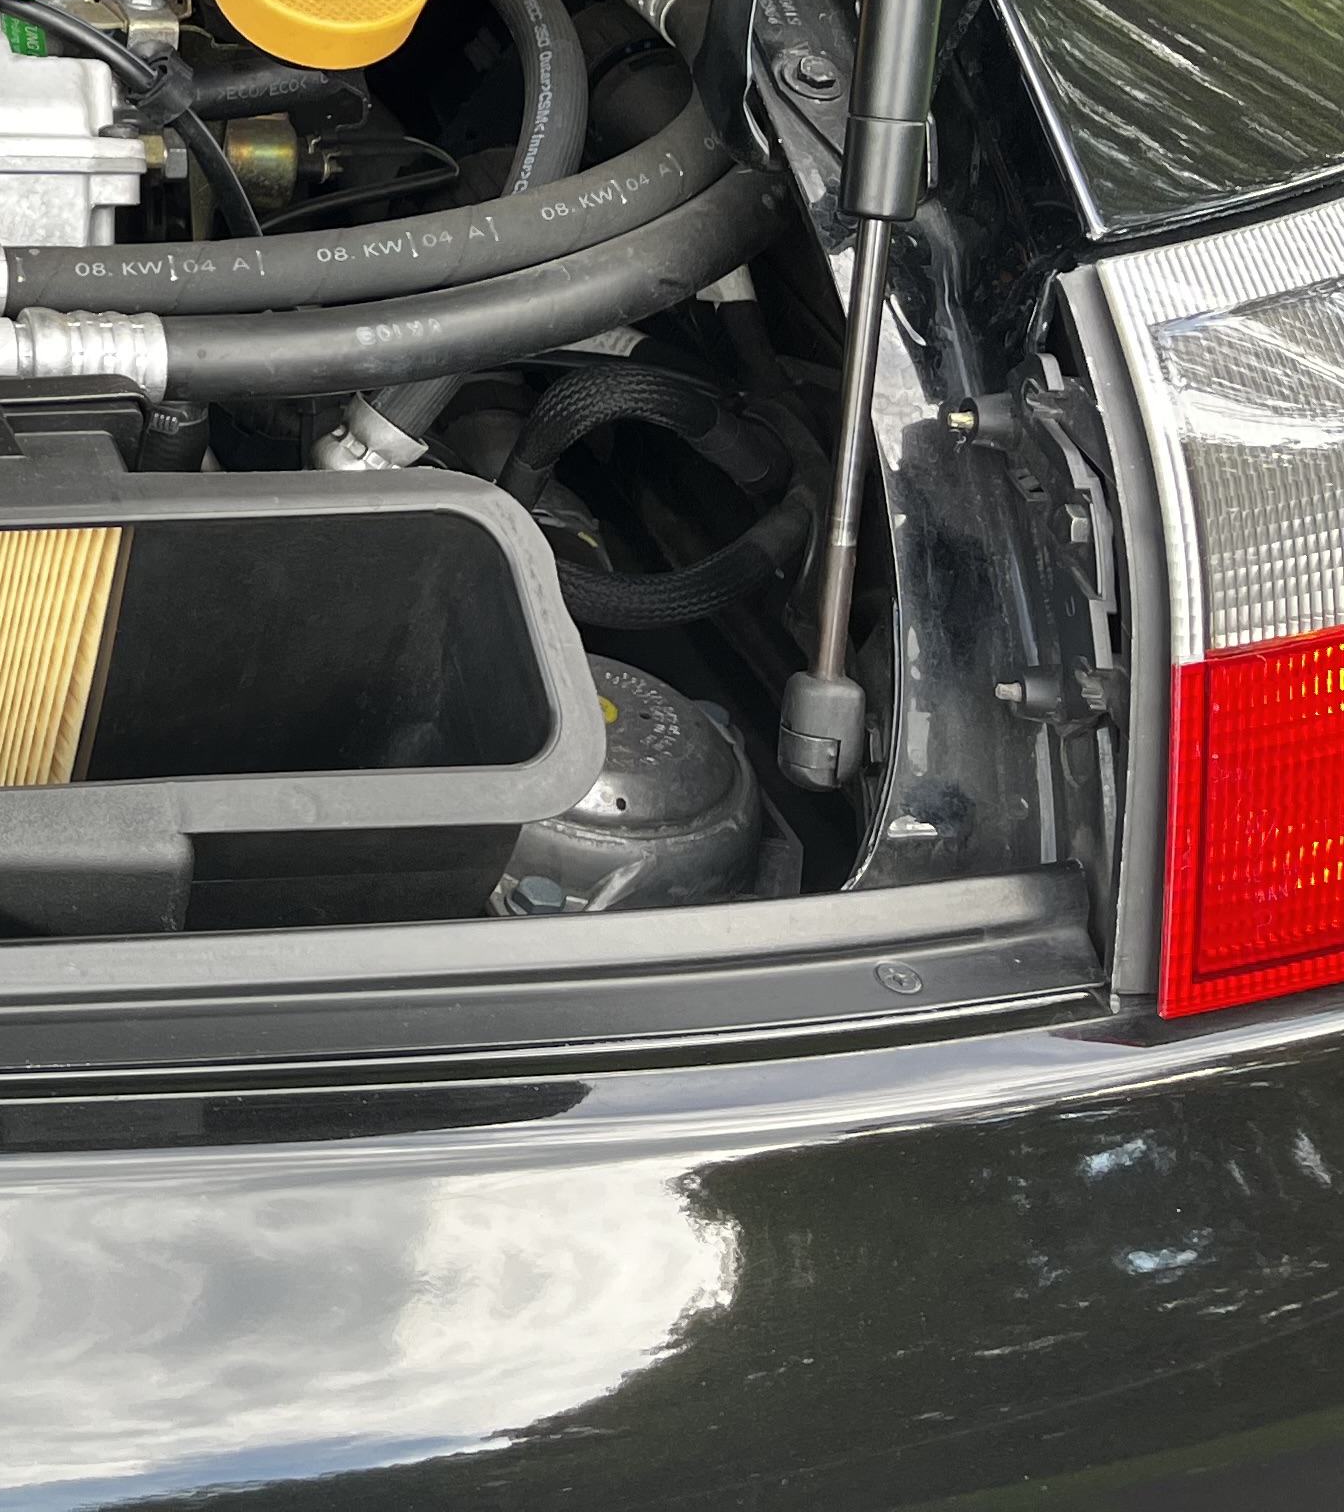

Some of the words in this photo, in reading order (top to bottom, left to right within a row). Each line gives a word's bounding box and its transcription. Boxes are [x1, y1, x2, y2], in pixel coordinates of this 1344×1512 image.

[364, 236, 403, 258] KW
[423, 230, 454, 248] 04
[468, 223, 486, 241] A
[121, 260, 163, 278] KW
